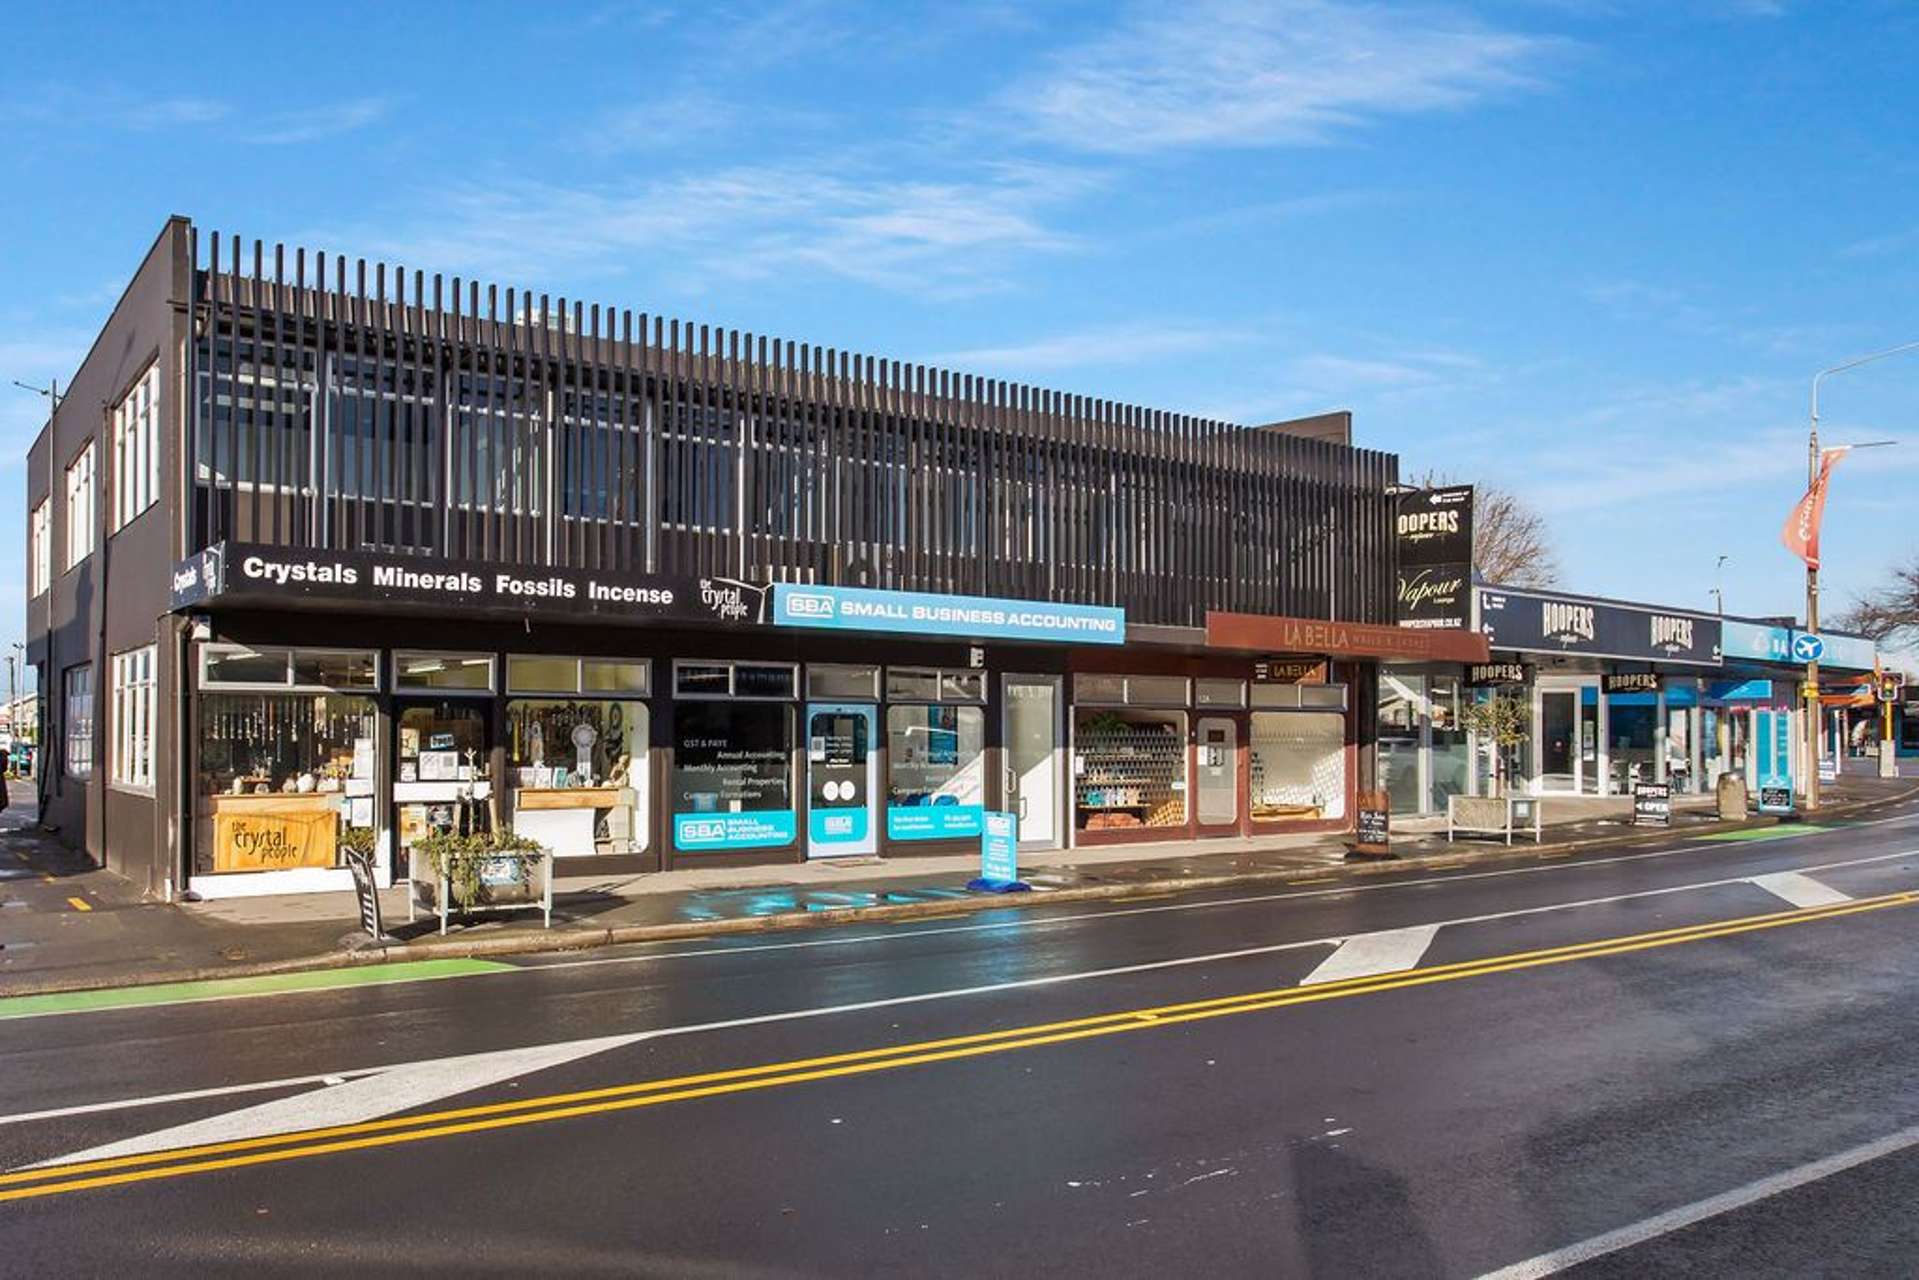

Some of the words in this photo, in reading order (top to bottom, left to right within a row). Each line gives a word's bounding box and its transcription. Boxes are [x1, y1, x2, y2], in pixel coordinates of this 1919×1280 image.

[1398, 510, 1459, 534] OOPERS
[243, 557, 357, 584] Crystals
[373, 566, 483, 592] Minerals
[496, 574, 576, 598] Fossils
[588, 581, 674, 604] Incense
[1399, 569, 1463, 611] Vapour
[790, 597, 833, 613] SBA
[840, 600, 908, 619] SMALL
[912, 608, 1006, 626] BUSINESS
[1007, 615, 1116, 632] ACCOUNTING
[1543, 602, 1594, 641] HOOPERS
[1284, 623, 1299, 648] LA
[1305, 626, 1350, 648] BELLA
[1651, 615, 1694, 649] HOOPERS
[1472, 664, 1522, 682] HOOPERS
[1608, 673, 1658, 689] HOOPERS
[234, 827, 287, 856] crystal
[684, 824, 725, 839] SBA
[261, 844, 298, 864] people
